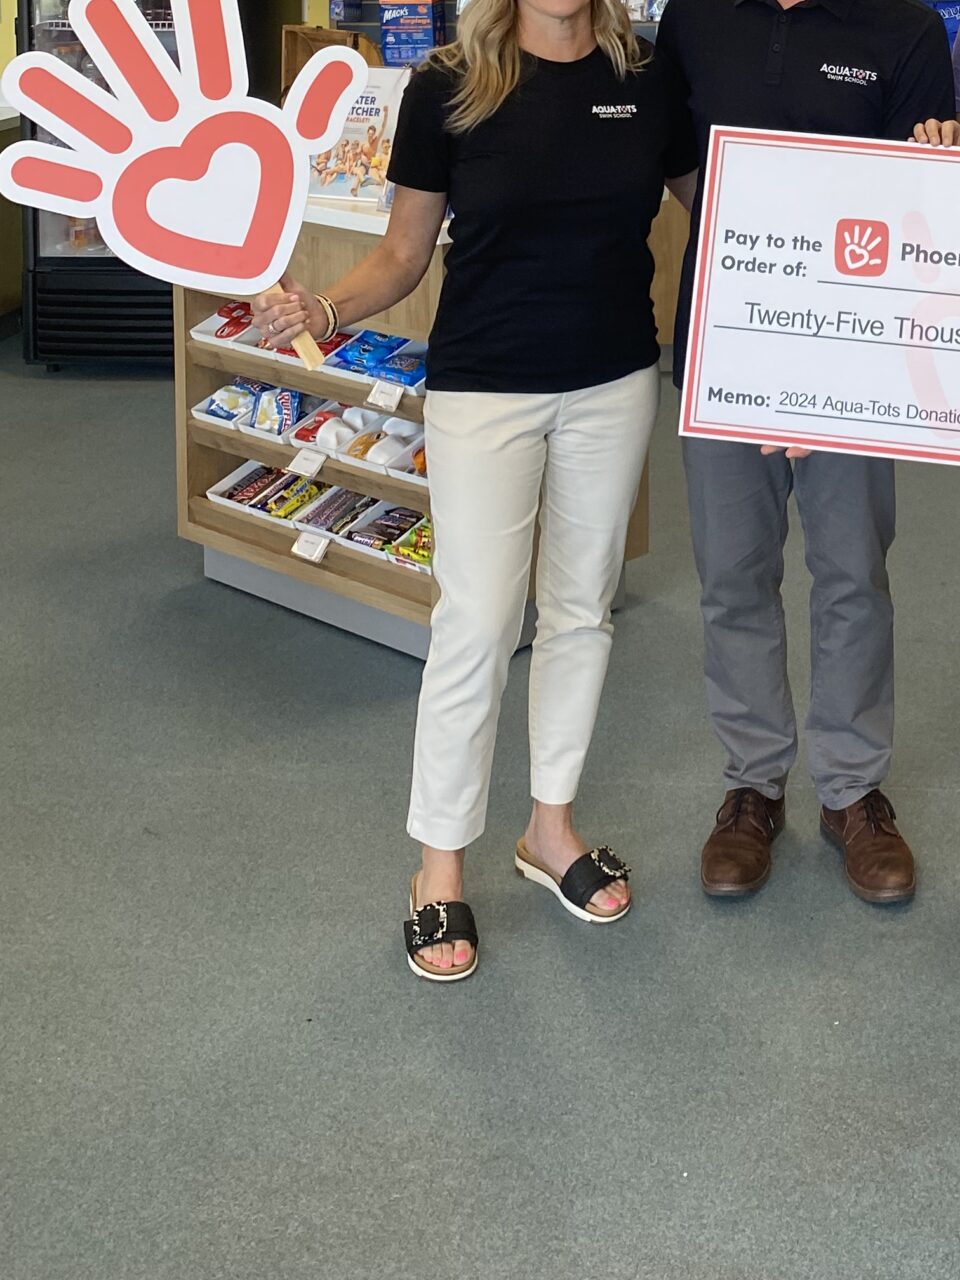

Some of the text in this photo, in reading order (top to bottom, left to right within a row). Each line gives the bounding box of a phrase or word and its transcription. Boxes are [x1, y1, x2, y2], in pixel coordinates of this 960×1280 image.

[383, 7, 408, 23] MACK'S
[820, 63, 878, 81] AQUA-TOTS
[827, 73, 868, 86] SWIM SCHOOL
[355, 95, 377, 105] ATER
[351, 107, 381, 117] TCHER
[591, 105, 637, 113] AQUA-TOTS
[723, 229, 823, 252] Pay to the
[721, 255, 807, 277] Order of:
[744, 302, 884, 337] Twenty-Five
[707, 386, 771, 407] Memo:
[779, 391, 817, 409] 2024
[822, 395, 900, 418] Aqua-Tots
